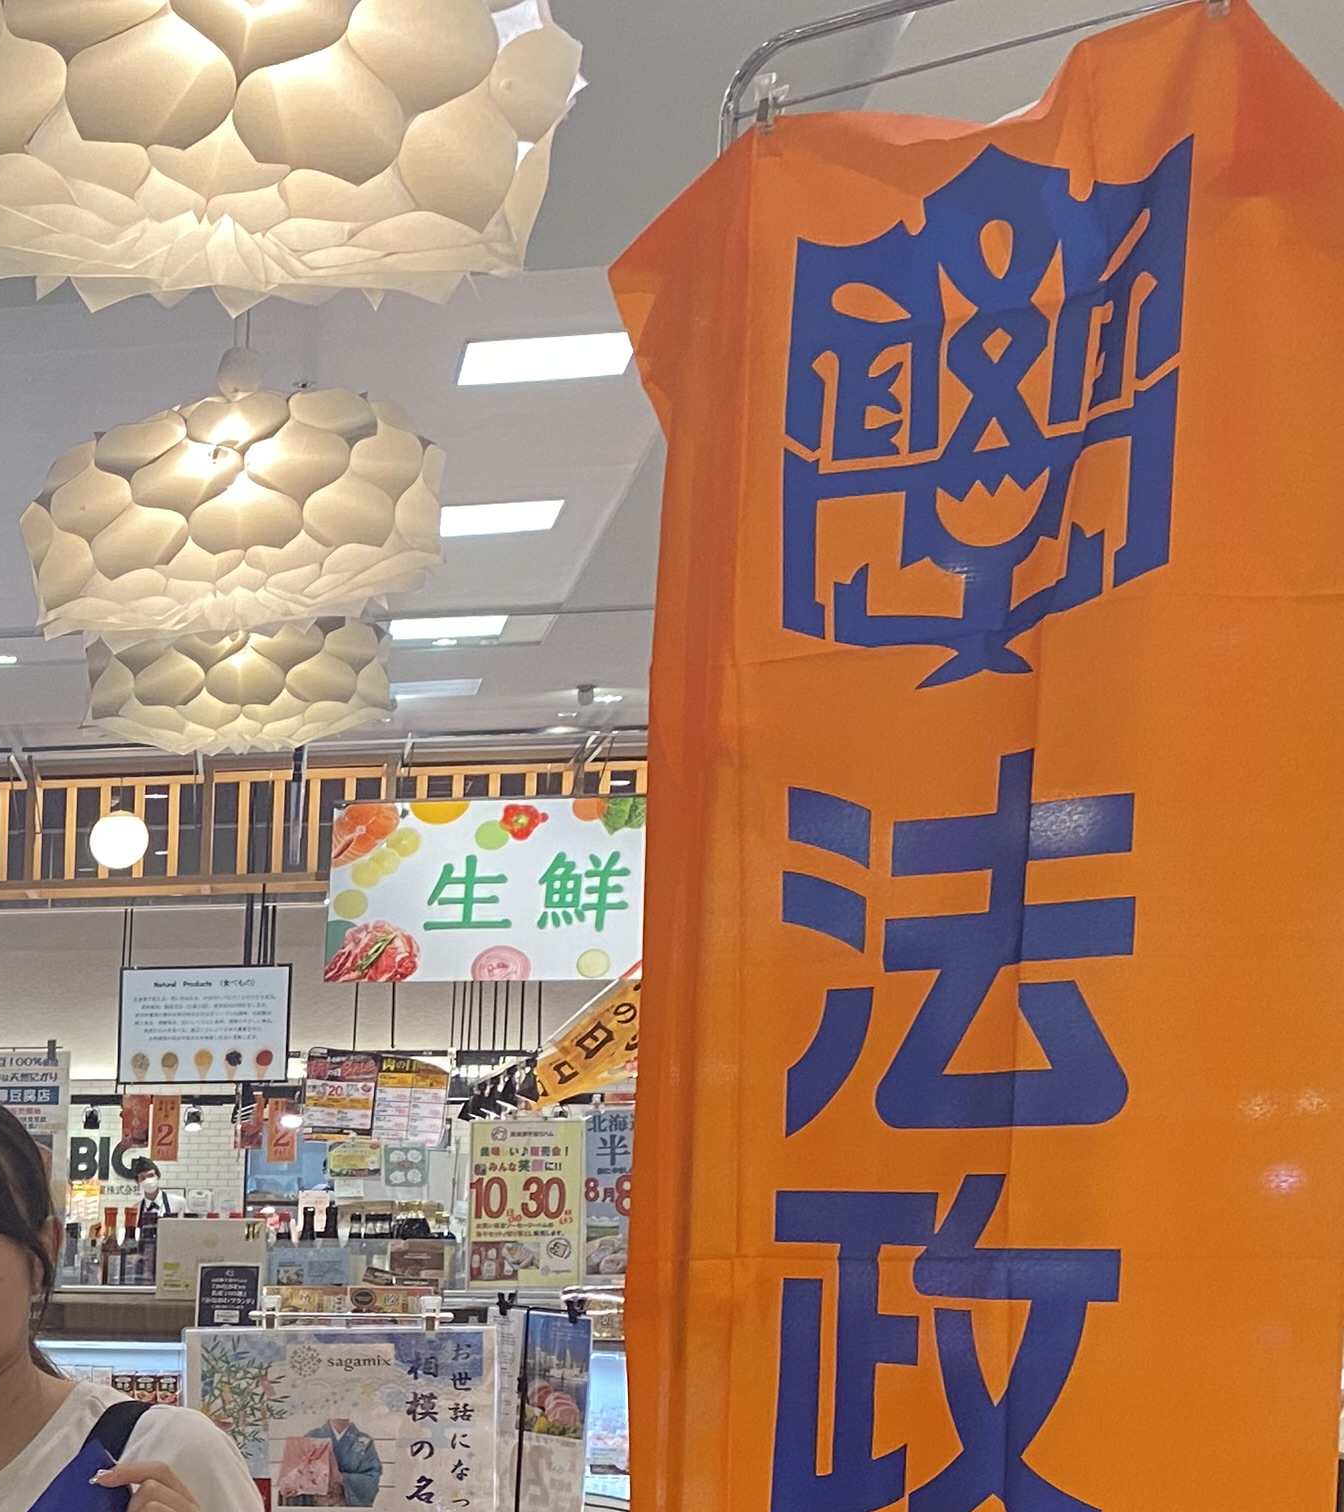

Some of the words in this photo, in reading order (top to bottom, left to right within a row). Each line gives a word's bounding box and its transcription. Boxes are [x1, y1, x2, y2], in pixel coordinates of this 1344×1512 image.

[423, 849, 632, 934] 生鮮
[156, 1123, 174, 1148] 2
[587, 1113, 635, 1133] 北海
[470, 1176, 508, 1220] 10
[520, 1176, 567, 1220] 30
[326, 1353, 394, 1372] sagamix
